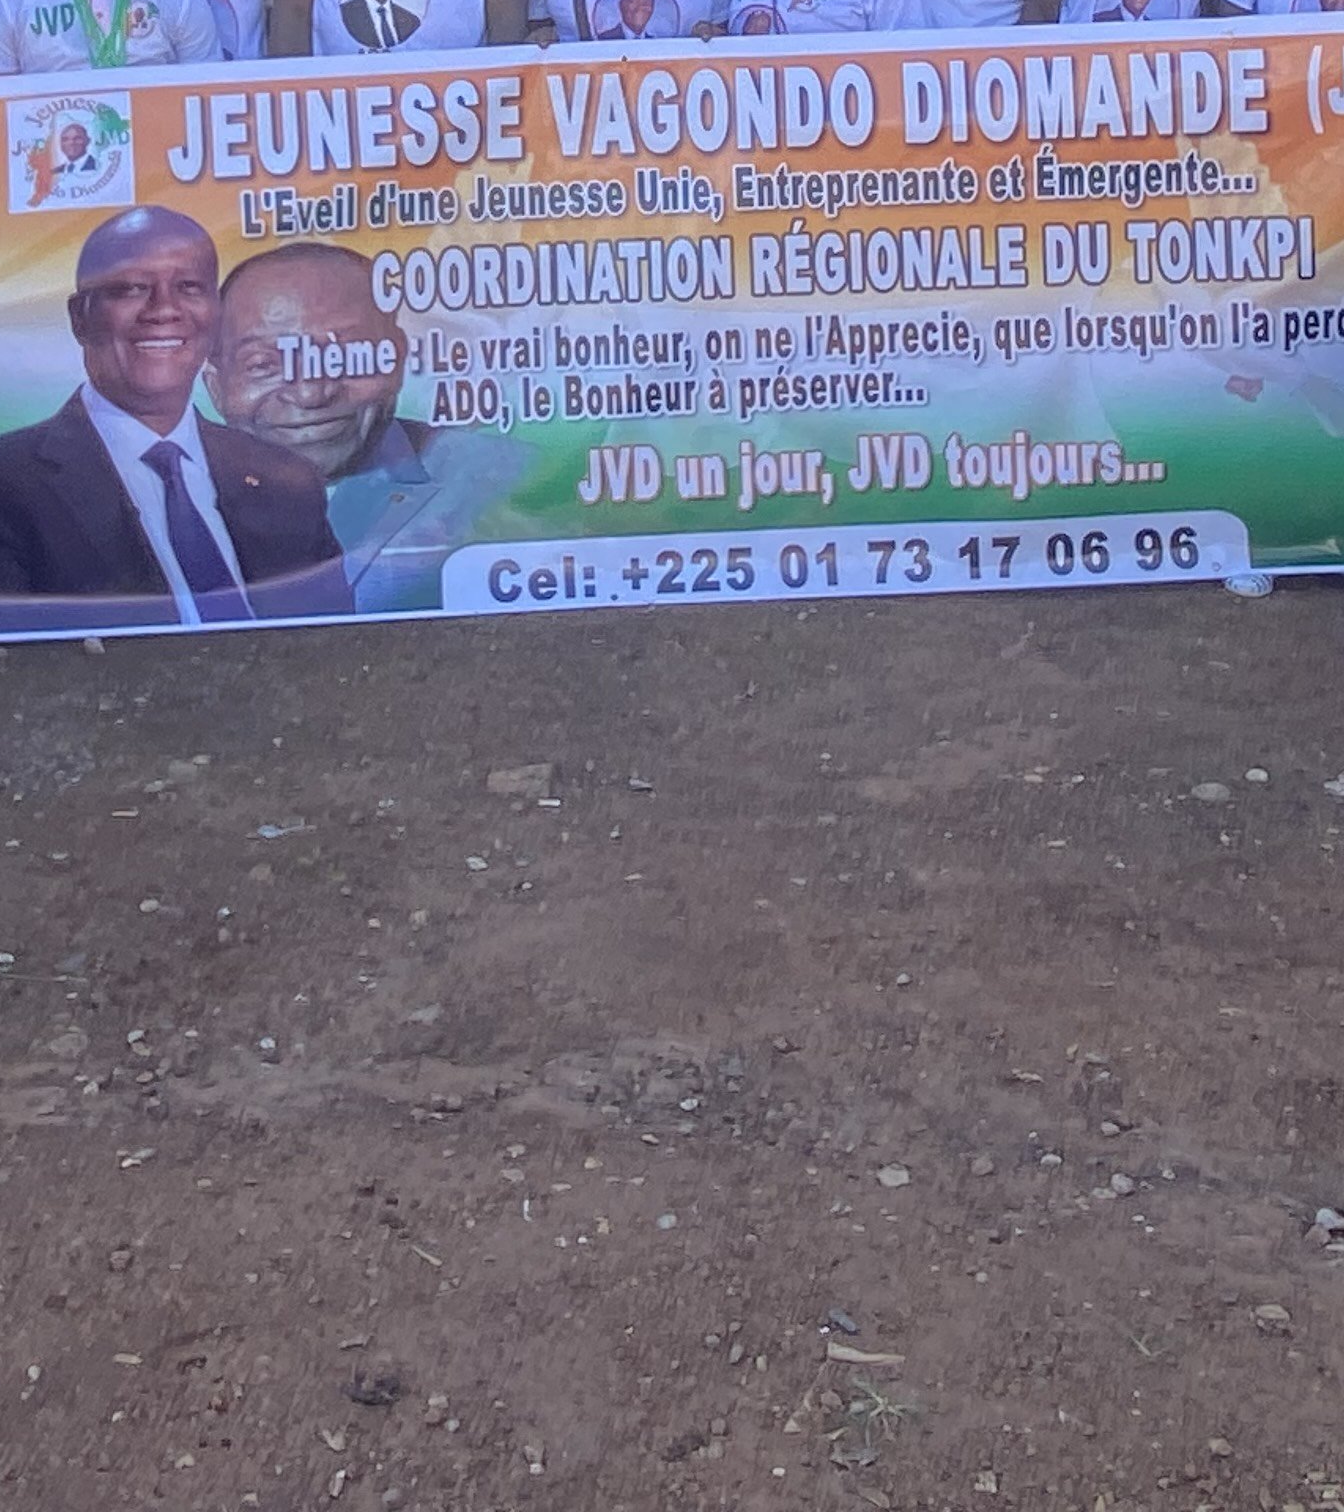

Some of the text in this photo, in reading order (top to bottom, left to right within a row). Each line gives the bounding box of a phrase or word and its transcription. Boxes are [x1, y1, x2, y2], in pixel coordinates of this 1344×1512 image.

[30, 2, 75, 36] JVD
[167, 76, 524, 182] JEUNESSE
[546, 62, 875, 157] VAGONDO
[902, 48, 1269, 145] DIOMANDE
[241, 142, 1257, 237] L'Eveil d'une Jeunesse Unie, Entreprenante et Émergente...
[371, 217, 1315, 314] COORDINATION RÉGIONALE DU TONKPI
[276, 331, 397, 382] Thème
[431, 329, 470, 373] Le
[480, 324, 546, 370] vrai
[556, 321, 694, 370] bonheur,
[706, 325, 743, 361] on
[755, 324, 794, 359] ne
[805, 310, 982, 365] l'Apprecie,
[994, 314, 1052, 361] que
[1064, 302, 1218, 357] lorsqu'on
[1230, 300, 1270, 345] l'a
[432, 364, 926, 431] ADO, le Bonheur à préserver...
[578, 429, 1168, 512] JVD un jour, JVD toujours...
[488, 525, 1200, 604] Cel: +225 01 73 17 06 96
